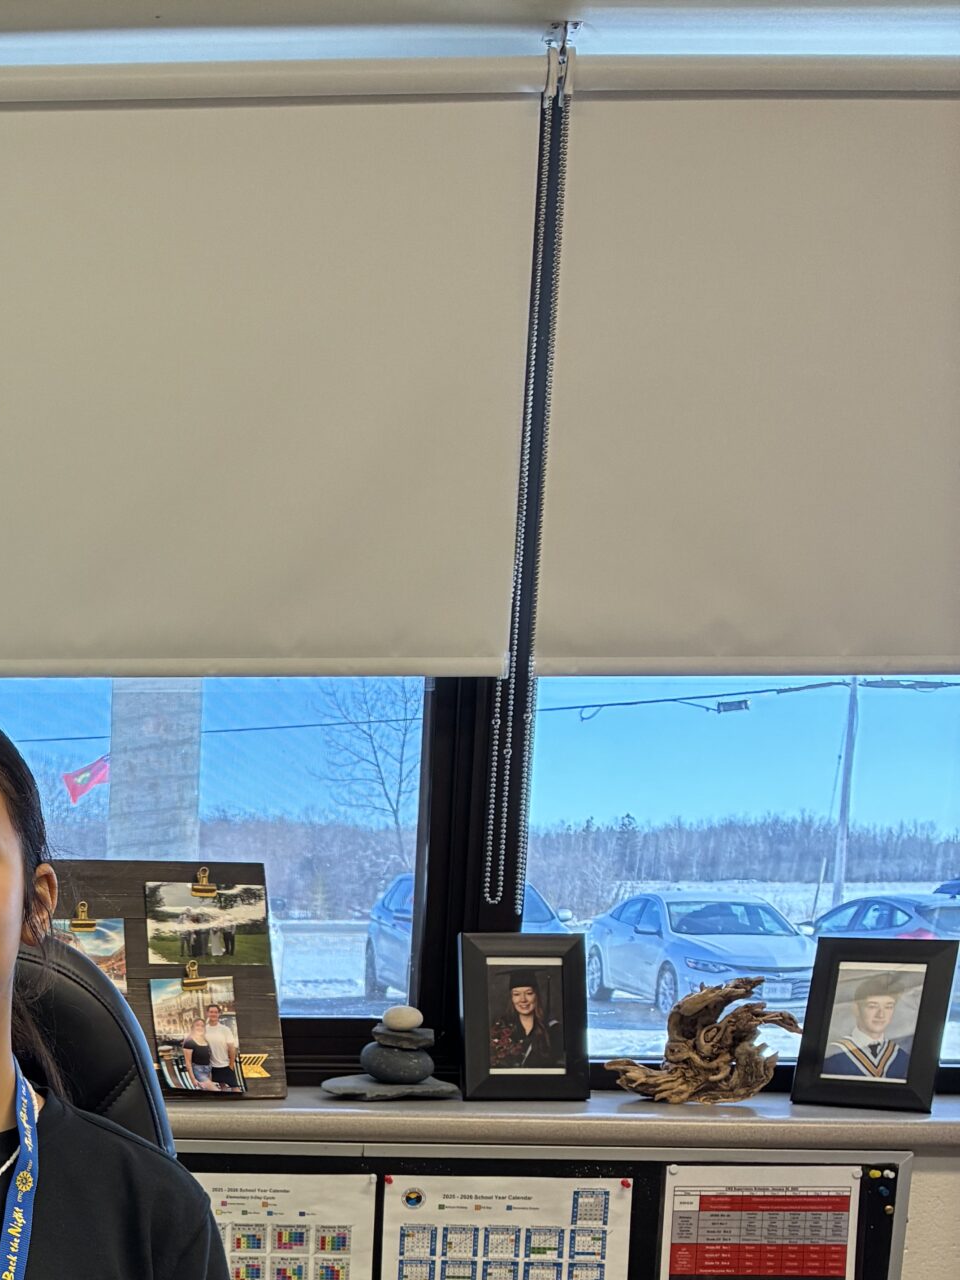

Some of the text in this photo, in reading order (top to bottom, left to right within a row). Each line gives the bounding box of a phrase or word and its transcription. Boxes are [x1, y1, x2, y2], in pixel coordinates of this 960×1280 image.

[8, 1206, 26, 1237] Night
[9, 1237, 21, 1254] the
[1, 1254, 18, 1280] Back
